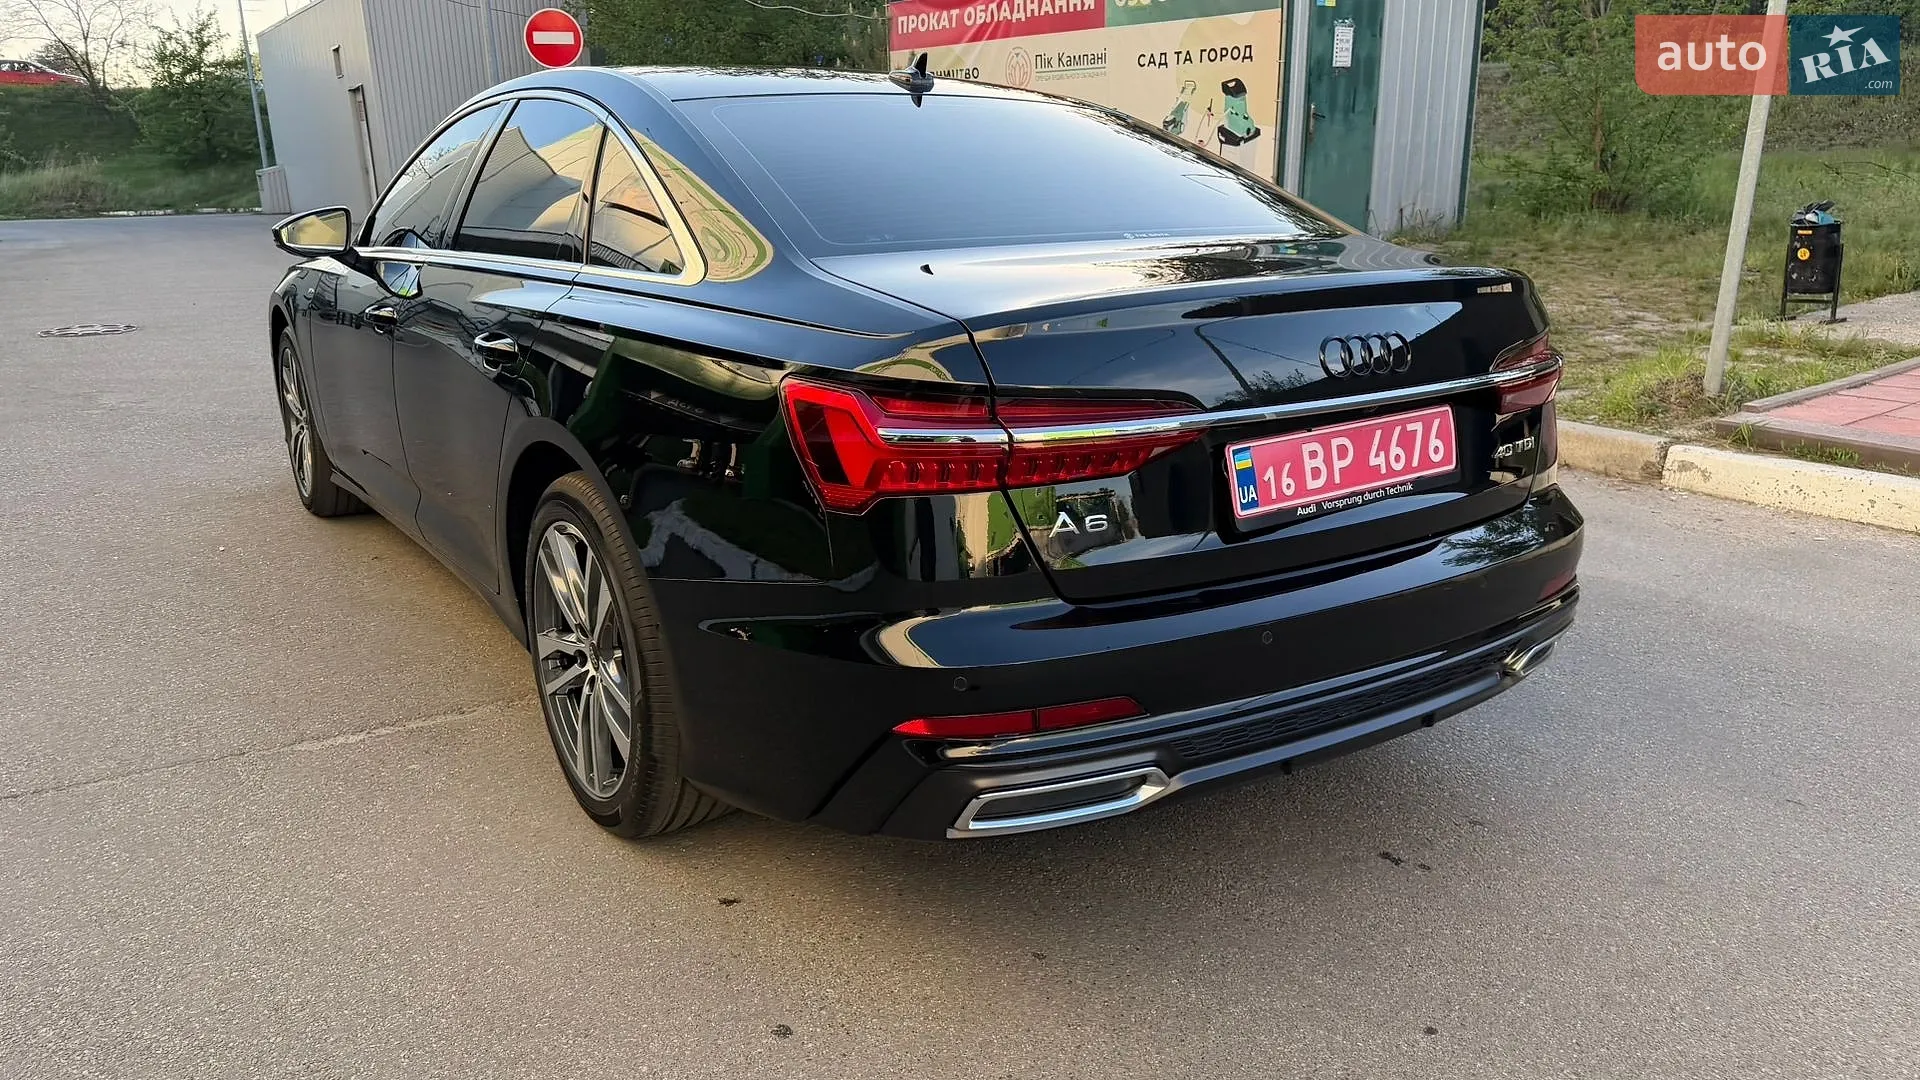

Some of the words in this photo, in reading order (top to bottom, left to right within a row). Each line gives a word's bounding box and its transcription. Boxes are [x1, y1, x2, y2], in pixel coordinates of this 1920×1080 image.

[898, 8, 960, 35] ПРОКАТ
[1035, 53, 1053, 69] Пік
[1057, 50, 1107, 67] Кампані
[1137, 52, 1168, 68] САД
[1174, 50, 1193, 65] ТА
[1199, 45, 1253, 64] ГОРОД
[1515, 436, 1535, 452] TDI
[1263, 462, 1296, 500] 16
[1369, 418, 1445, 475] 4676
[1239, 484, 1258, 504] UA
[1297, 503, 1317, 516] Audi
[1321, 495, 1363, 509] Vorsprung
[1363, 488, 1386, 501] durch
[1385, 482, 1414, 496] Technik
[1049, 511, 1109, 538] A6
